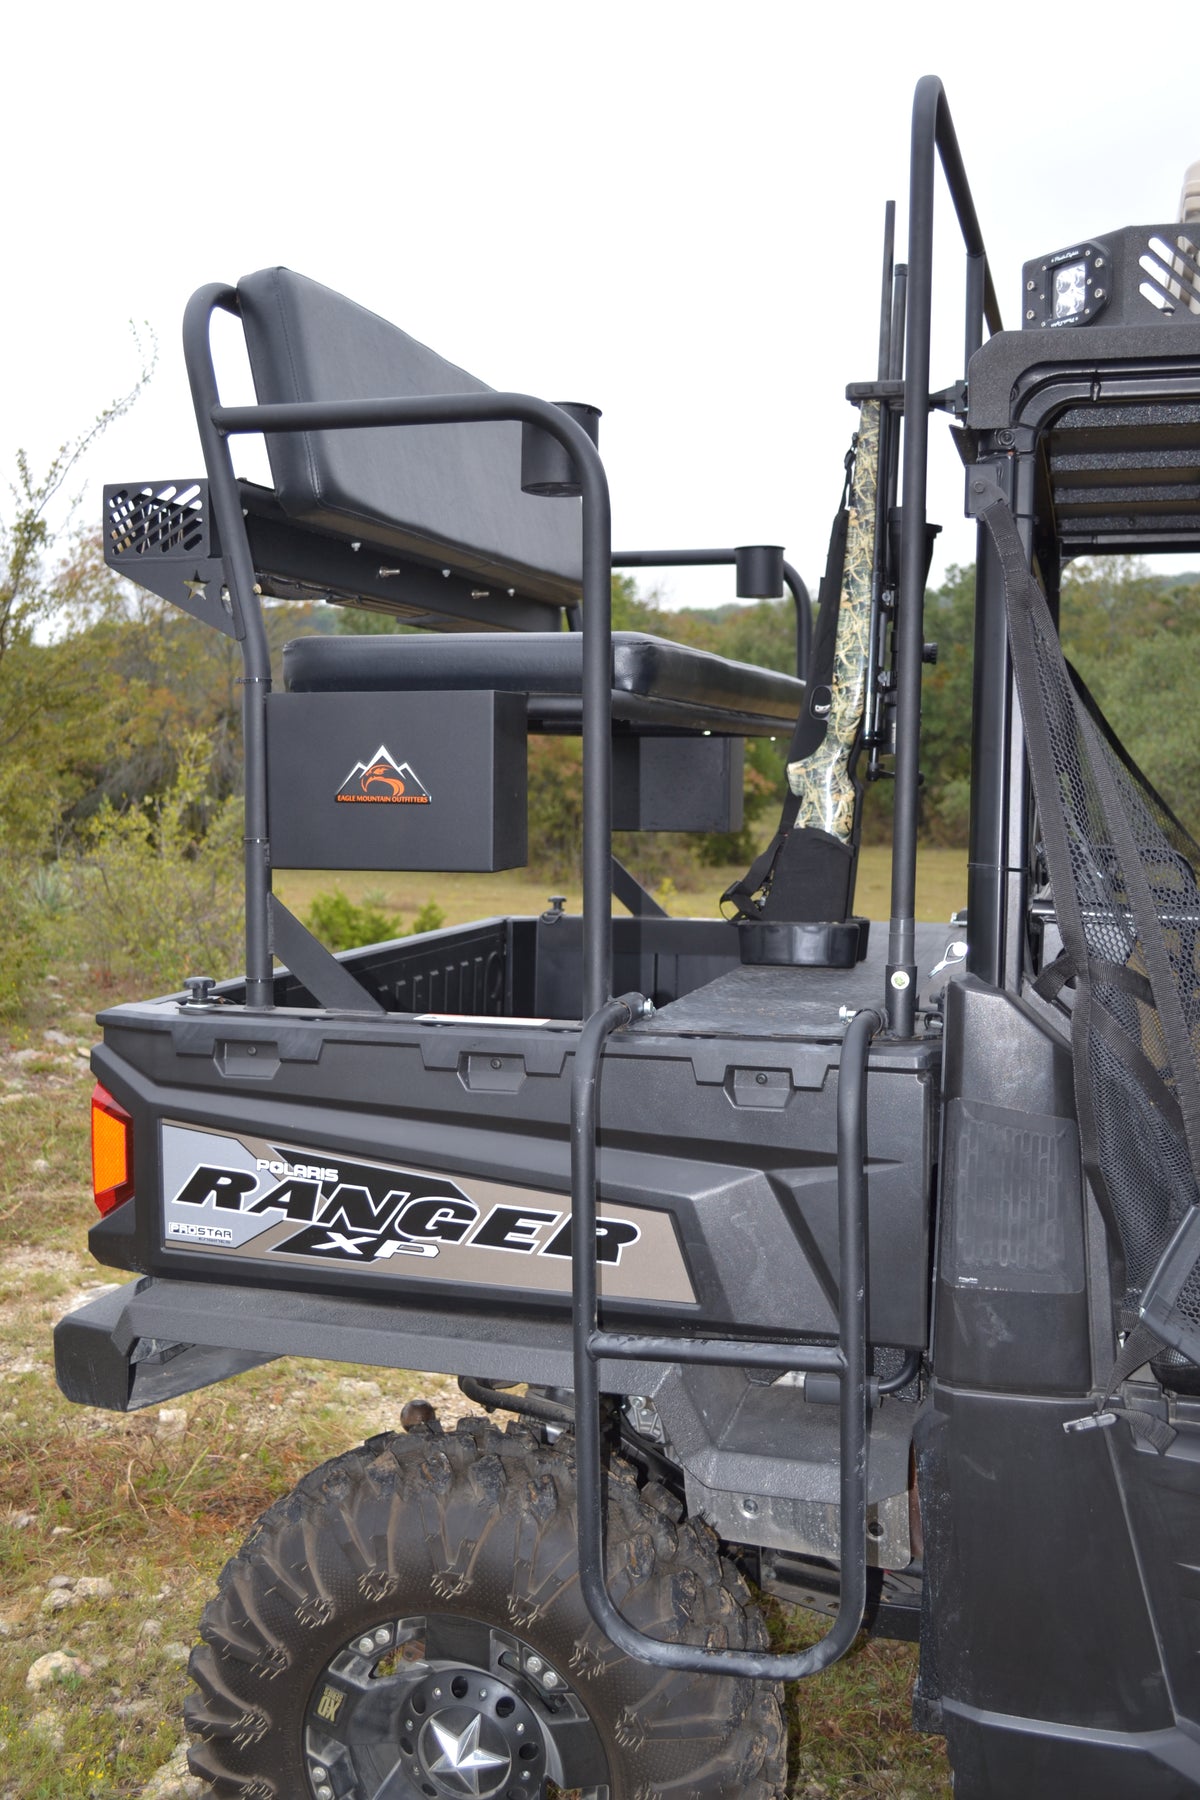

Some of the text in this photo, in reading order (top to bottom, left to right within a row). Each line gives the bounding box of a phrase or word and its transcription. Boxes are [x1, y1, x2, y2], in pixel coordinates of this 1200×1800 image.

[337, 794, 356, 802] EAGLE
[256, 1158, 339, 1182] POLARIS
[171, 1163, 641, 1266] RANGER
[169, 1222, 232, 1239] PROSTAR
[310, 1231, 440, 1259] XP
